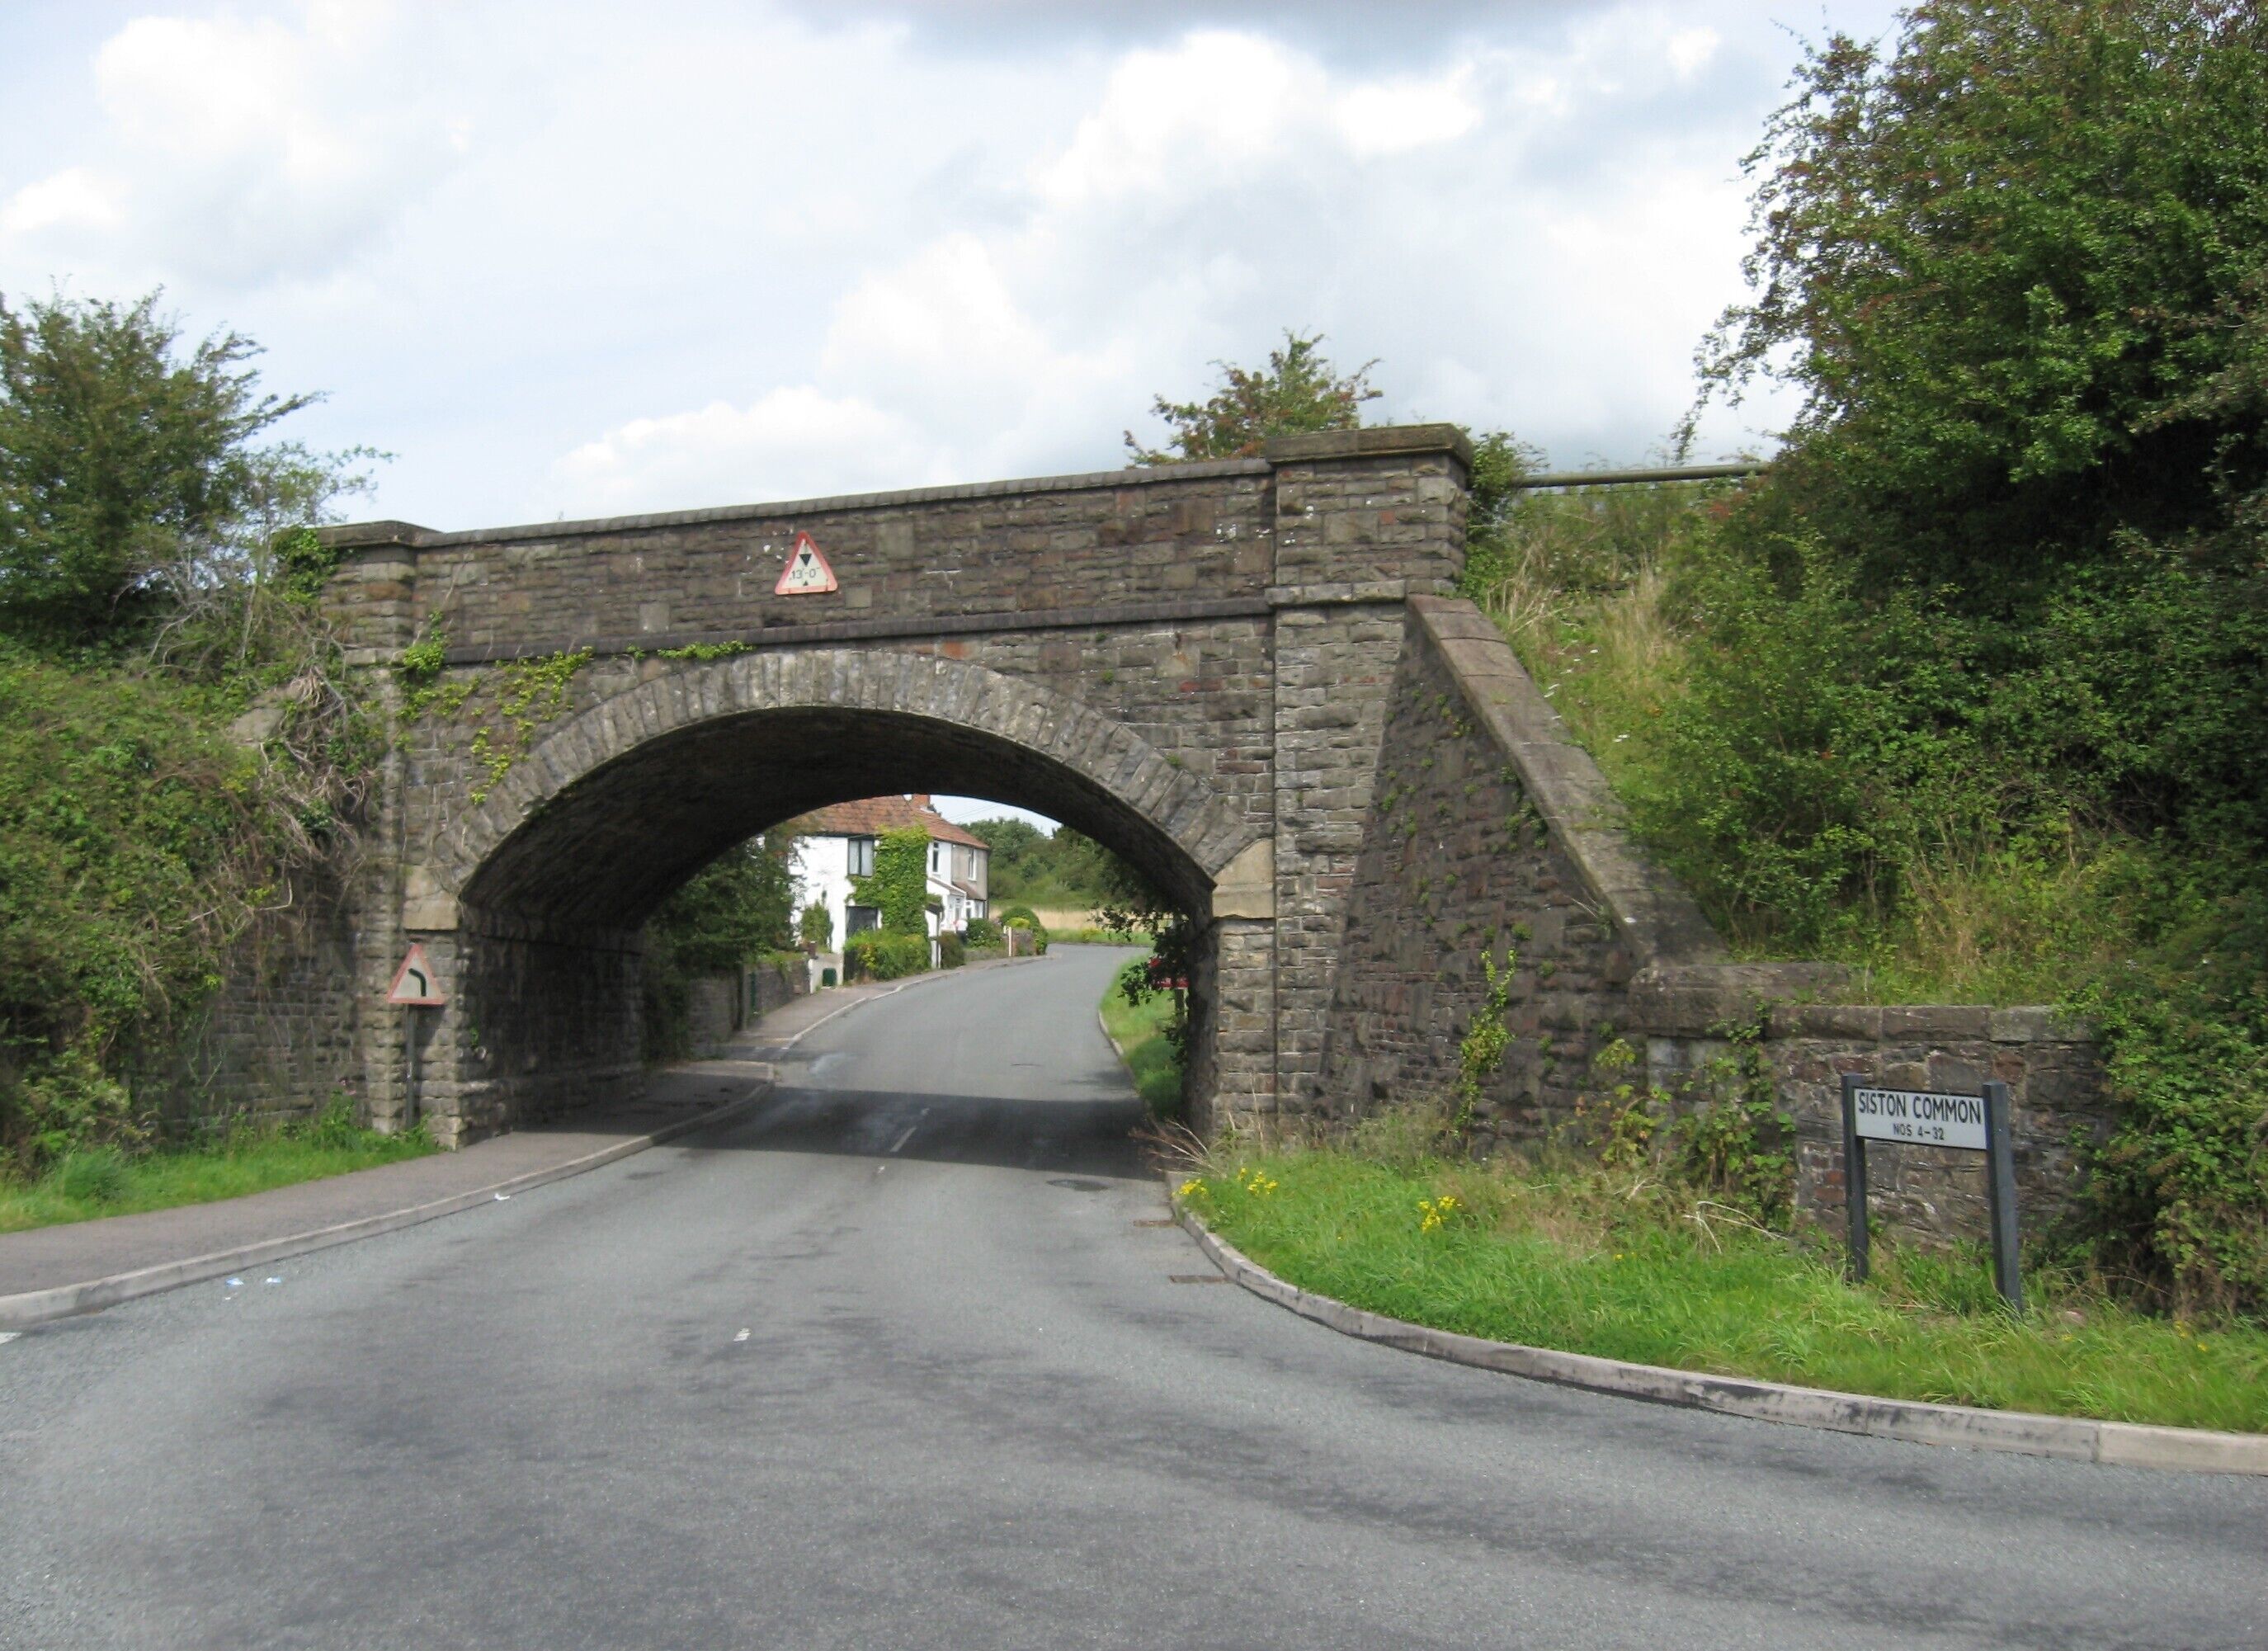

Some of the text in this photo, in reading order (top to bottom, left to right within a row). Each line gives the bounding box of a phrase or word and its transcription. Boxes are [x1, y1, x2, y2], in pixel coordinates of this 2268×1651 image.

[1859, 1092, 1981, 1124] SISTON COMMON
[1893, 1123, 1945, 1140] NOS 4-32
